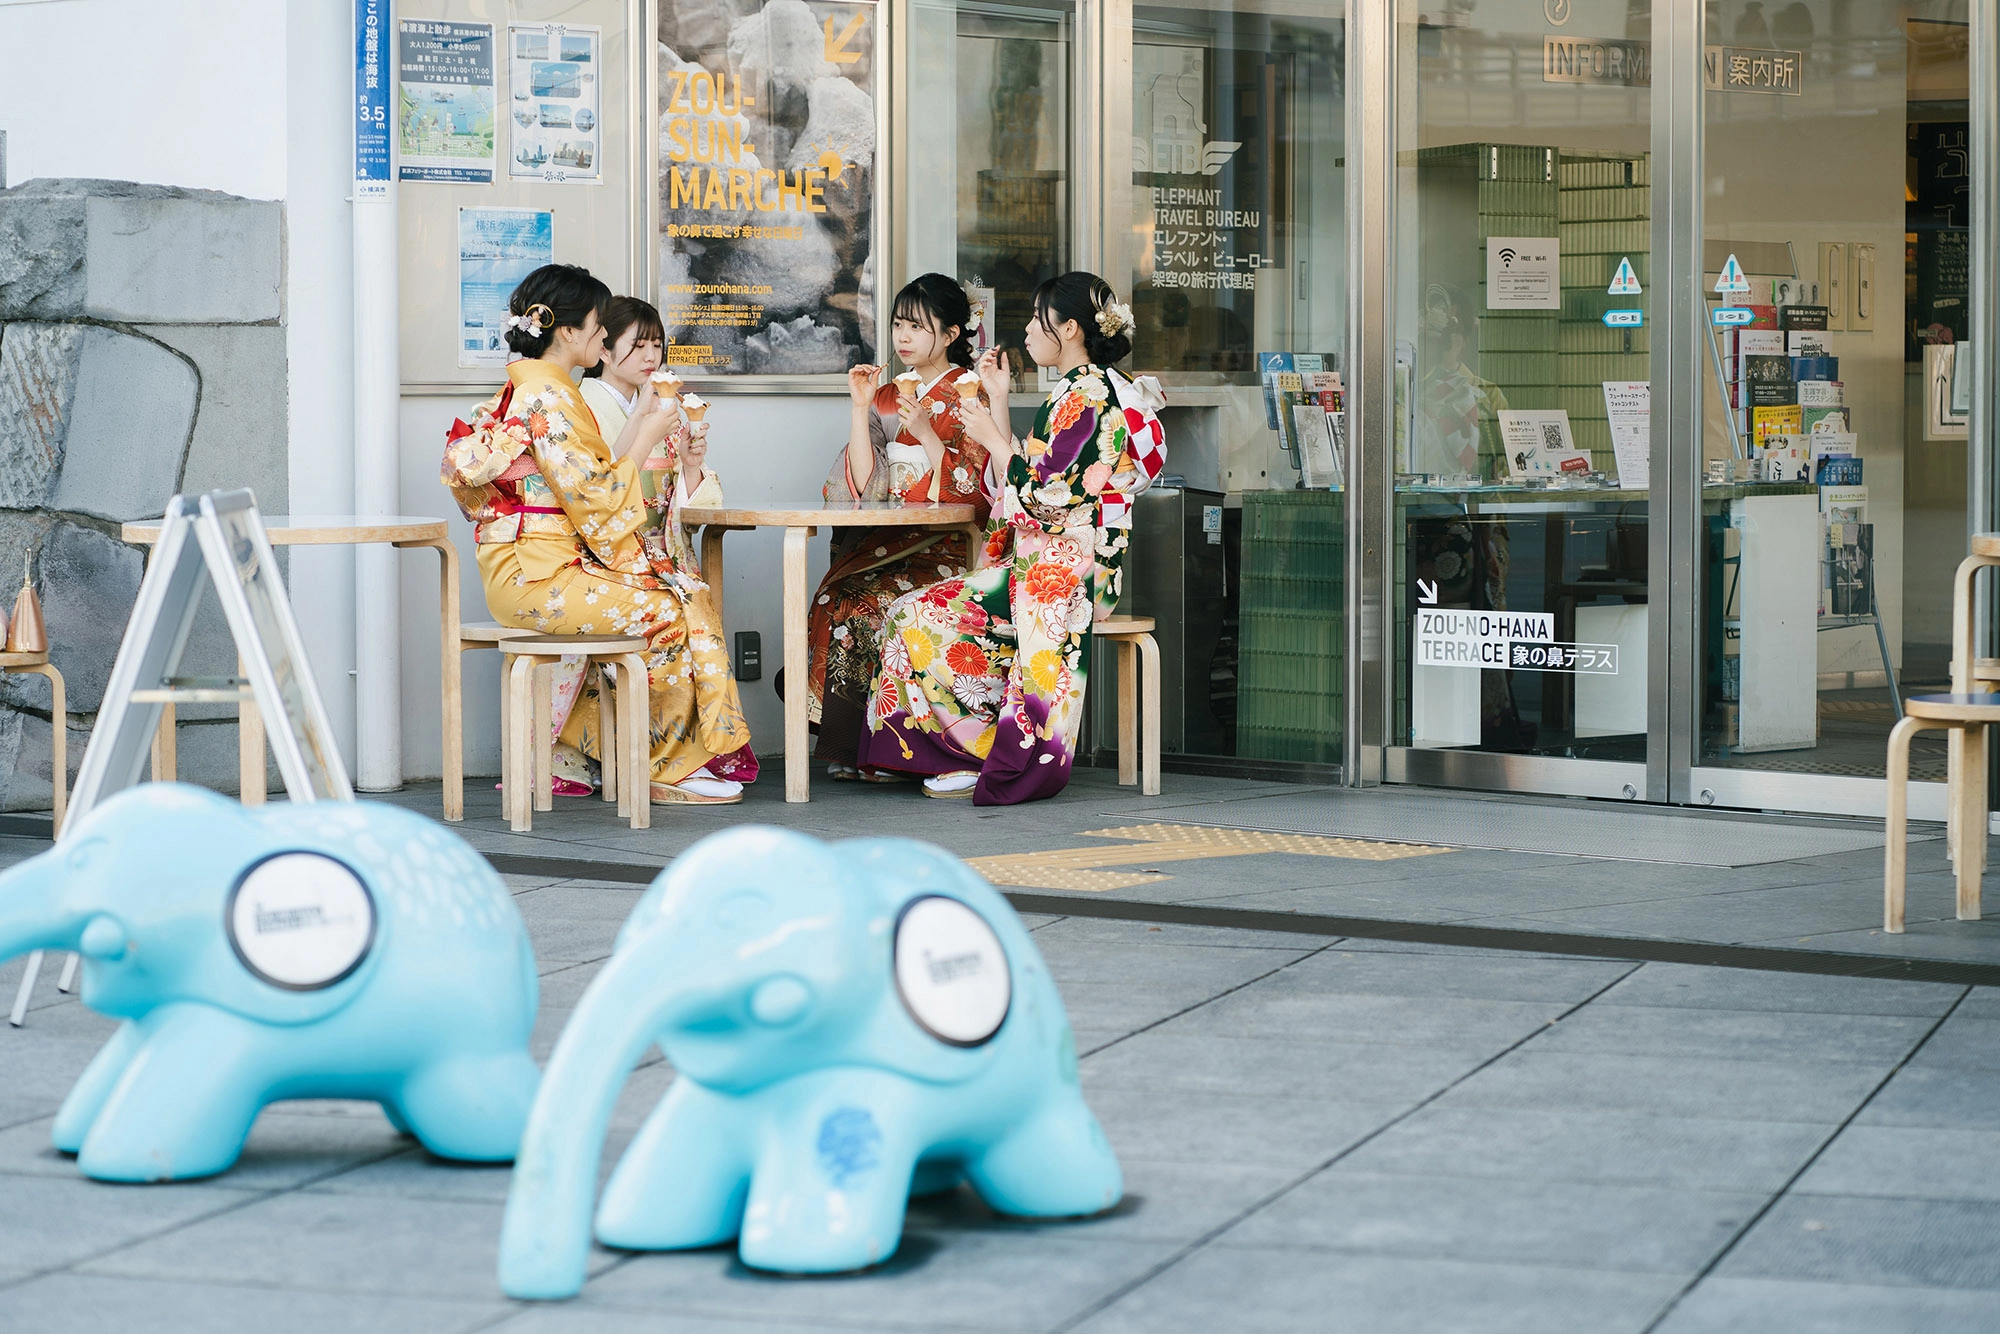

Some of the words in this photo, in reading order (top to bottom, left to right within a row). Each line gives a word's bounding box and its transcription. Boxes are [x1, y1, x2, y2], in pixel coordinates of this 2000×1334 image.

[366, 0, 378, 89] この地盤は海抜
[1728, 55, 1795, 89] 案内所
[359, 94, 368, 105] 約
[667, 70, 755, 117] ZOU-
[360, 106, 385, 121] 3.5
[375, 121, 385, 129] m
[668, 118, 755, 164] SUN-
[1153, 188, 1222, 206] ELEPHANT
[1153, 208, 1202, 226] TRAVEL
[1205, 211, 1260, 228] BUREAU
[667, 223, 803, 240] 象の鼻で過ごす幸せな日曜日
[1152, 250, 1273, 268] トラベル・ビューロー
[667, 282, 773, 295] www.zounohana.com
[1152, 271, 1255, 290] 架空の旅行代理店
[669, 347, 711, 355] ZOU-NO-HANA
[1422, 614, 1549, 639] ZOU-NO-HANA
[1422, 640, 1504, 663] TERRACE
[1512, 645, 1613, 669] 象の鼻テラス
